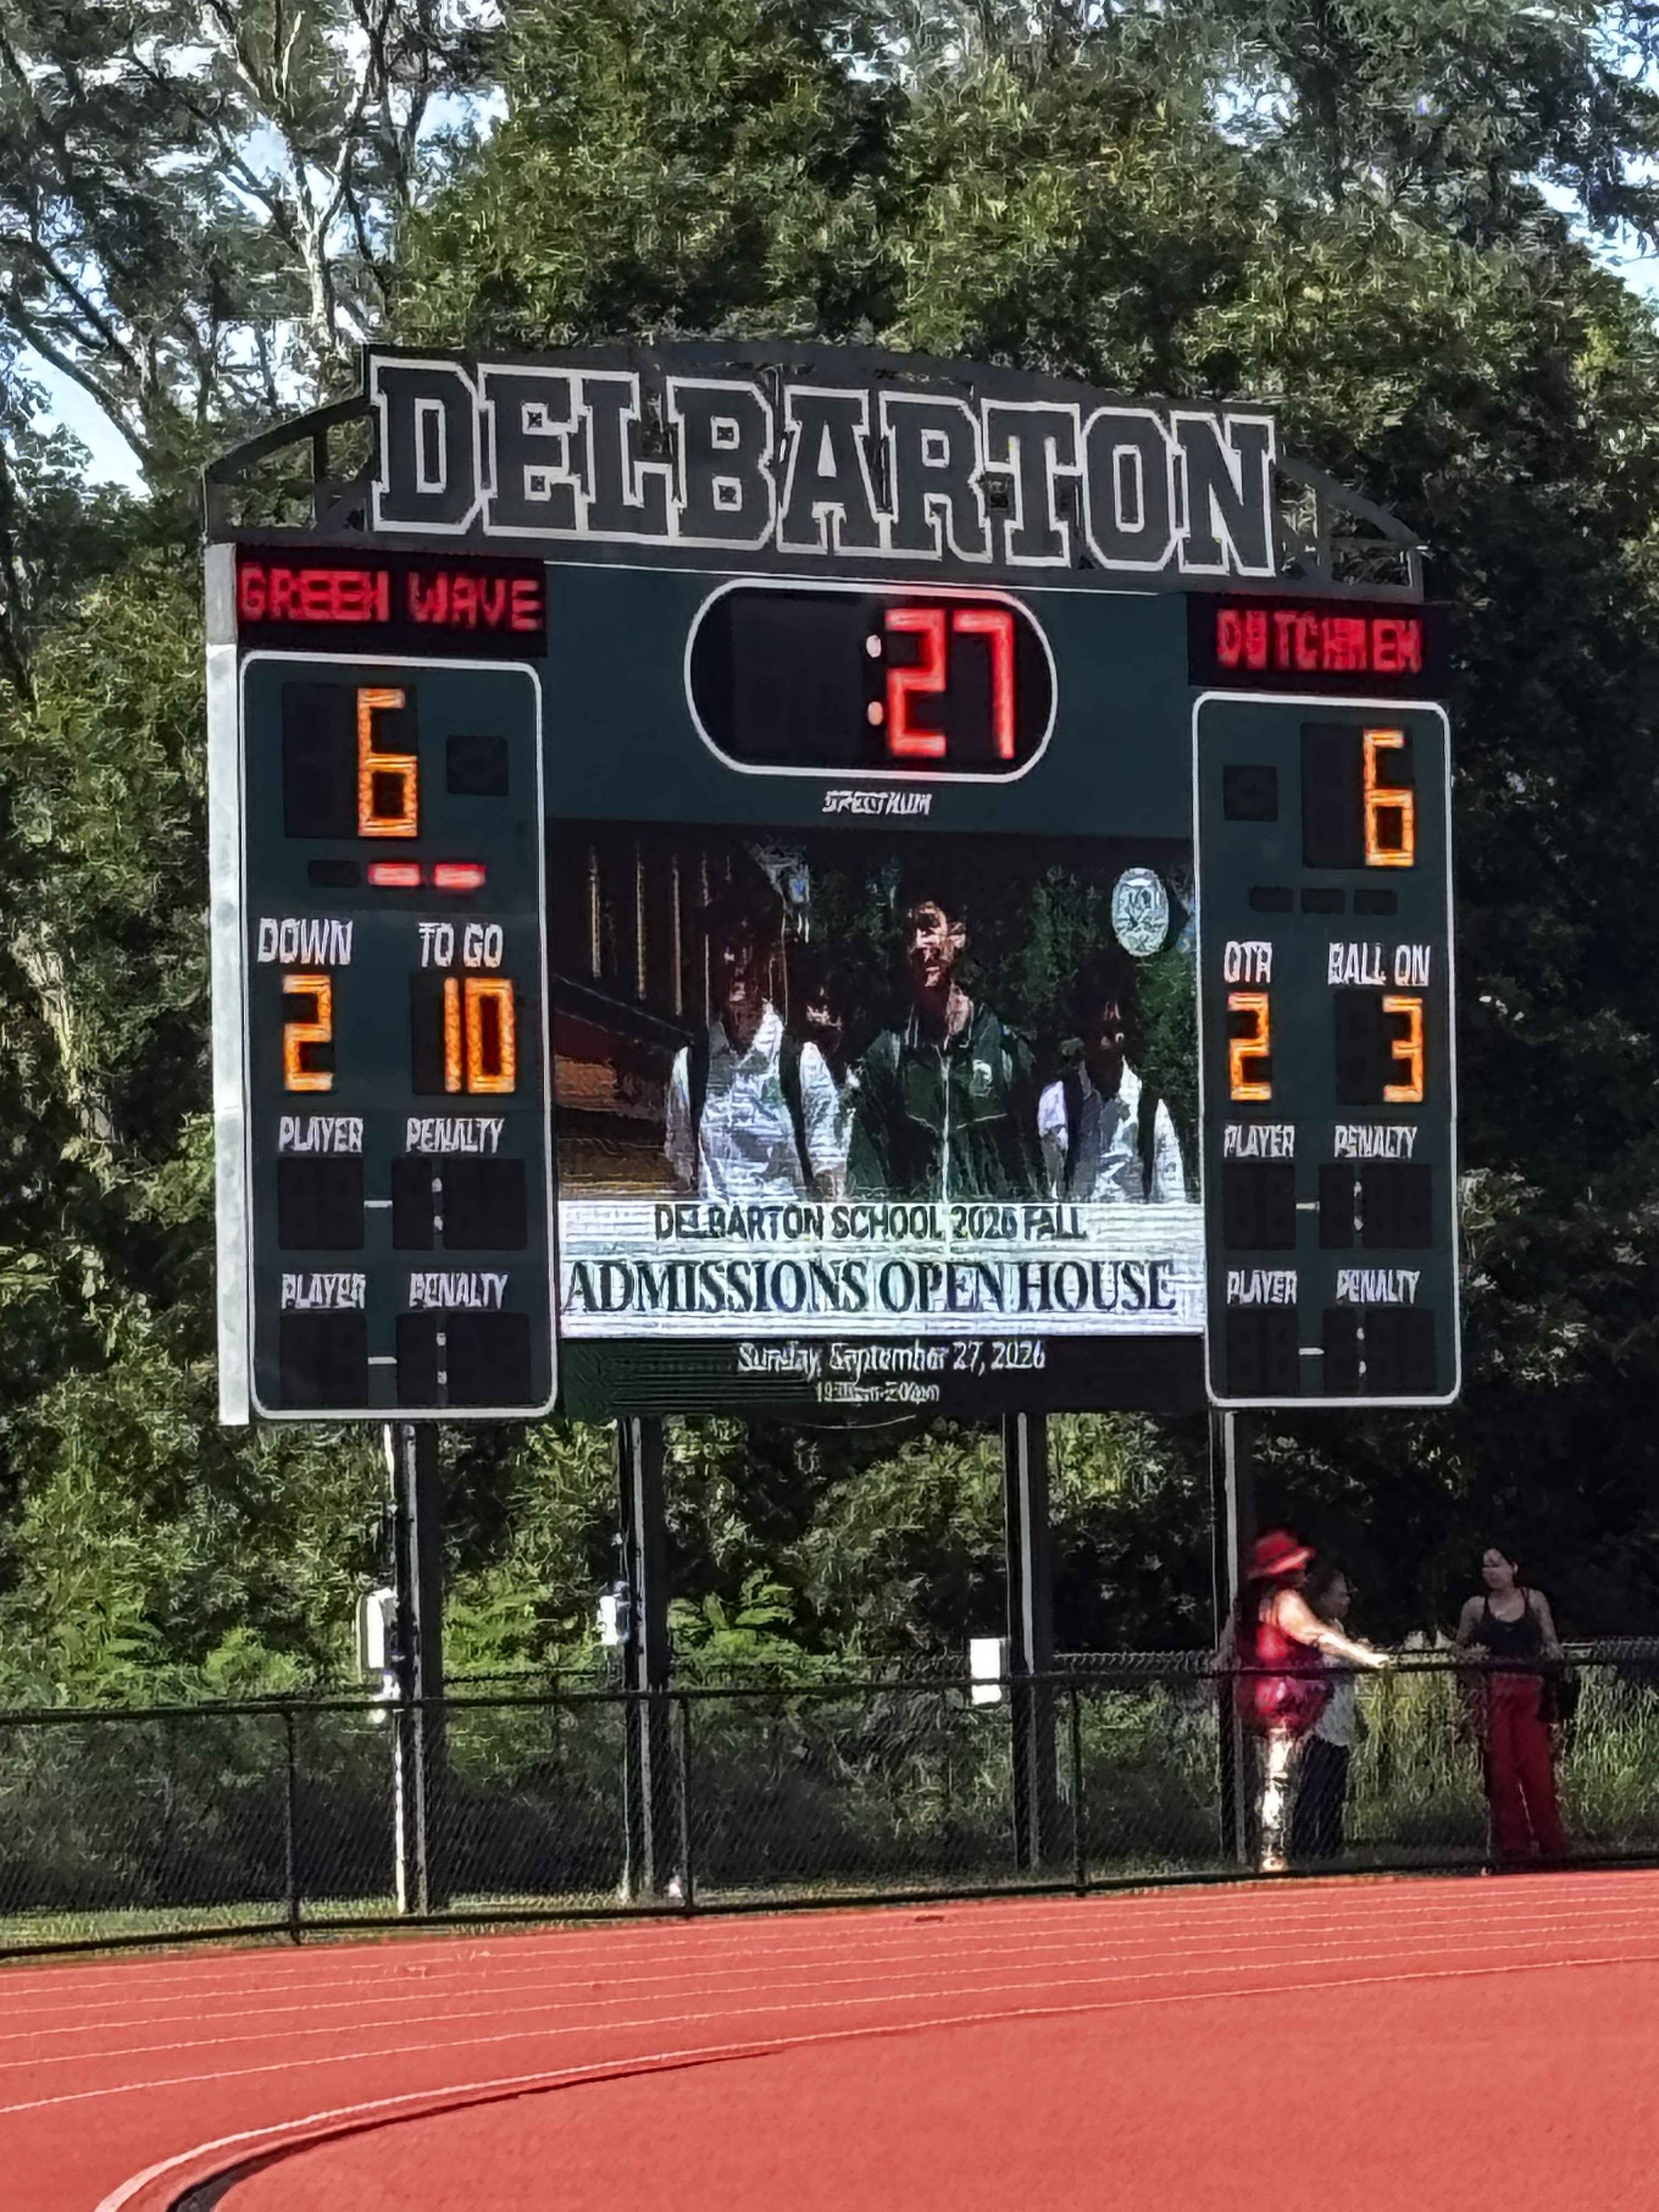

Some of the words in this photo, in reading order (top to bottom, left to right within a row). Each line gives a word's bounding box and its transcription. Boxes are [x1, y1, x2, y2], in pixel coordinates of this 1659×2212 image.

[369, 354, 1277, 578] DELBARTON
[241, 563, 389, 622] GREEN
[408, 571, 543, 631] WAVE
[1217, 609, 1423, 674] DUTCHMEN
[357, 687, 419, 837] 6
[1363, 729, 1415, 867] 6
[257, 917, 353, 966] DOWN
[418, 922, 455, 967] TO
[463, 922, 504, 968] GO
[1223, 941, 1273, 984] QTR
[1328, 943, 1387, 986] BALL
[1393, 945, 1431, 987] ON
[282, 974, 333, 1092] 2
[443, 977, 516, 1094] 10
[1228, 992, 1272, 1101] 2
[1382, 995, 1424, 1104] 3
[279, 1116, 364, 1153] PLAYER
[405, 1118, 505, 1153] PENALTY
[1223, 1124, 1295, 1159] PLAYER
[1334, 1125, 1418, 1160] PENALTY
[654, 1204, 823, 1241] DELBARTON
[831, 1205, 943, 1239] SCHOOL
[281, 1273, 366, 1309] PLAYER
[409, 1272, 509, 1309] PENALTY
[561, 1260, 870, 1313] ADMISSIONS
[879, 1260, 1004, 1313] OPEN
[1007, 1260, 1177, 1312] HOUSE
[1227, 1269, 1297, 1305] PLAYER
[1335, 1269, 1421, 1305] PENALTY
